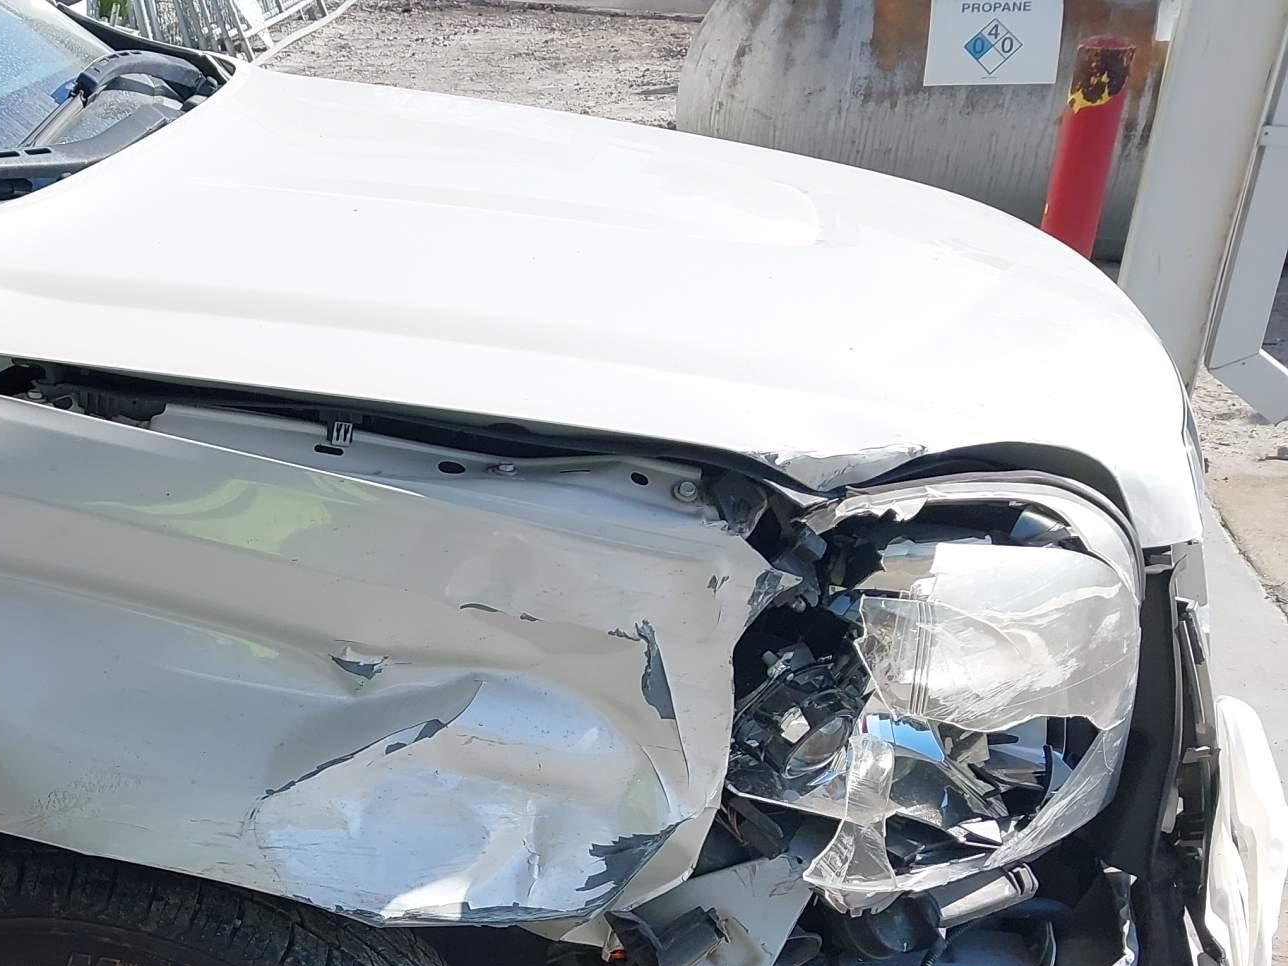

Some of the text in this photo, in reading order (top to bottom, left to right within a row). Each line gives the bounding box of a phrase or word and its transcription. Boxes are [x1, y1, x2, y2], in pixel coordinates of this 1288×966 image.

[961, 1, 1032, 14] PROPANE
[987, 23, 1000, 39] 4
[972, 36, 1013, 54] 0 0
